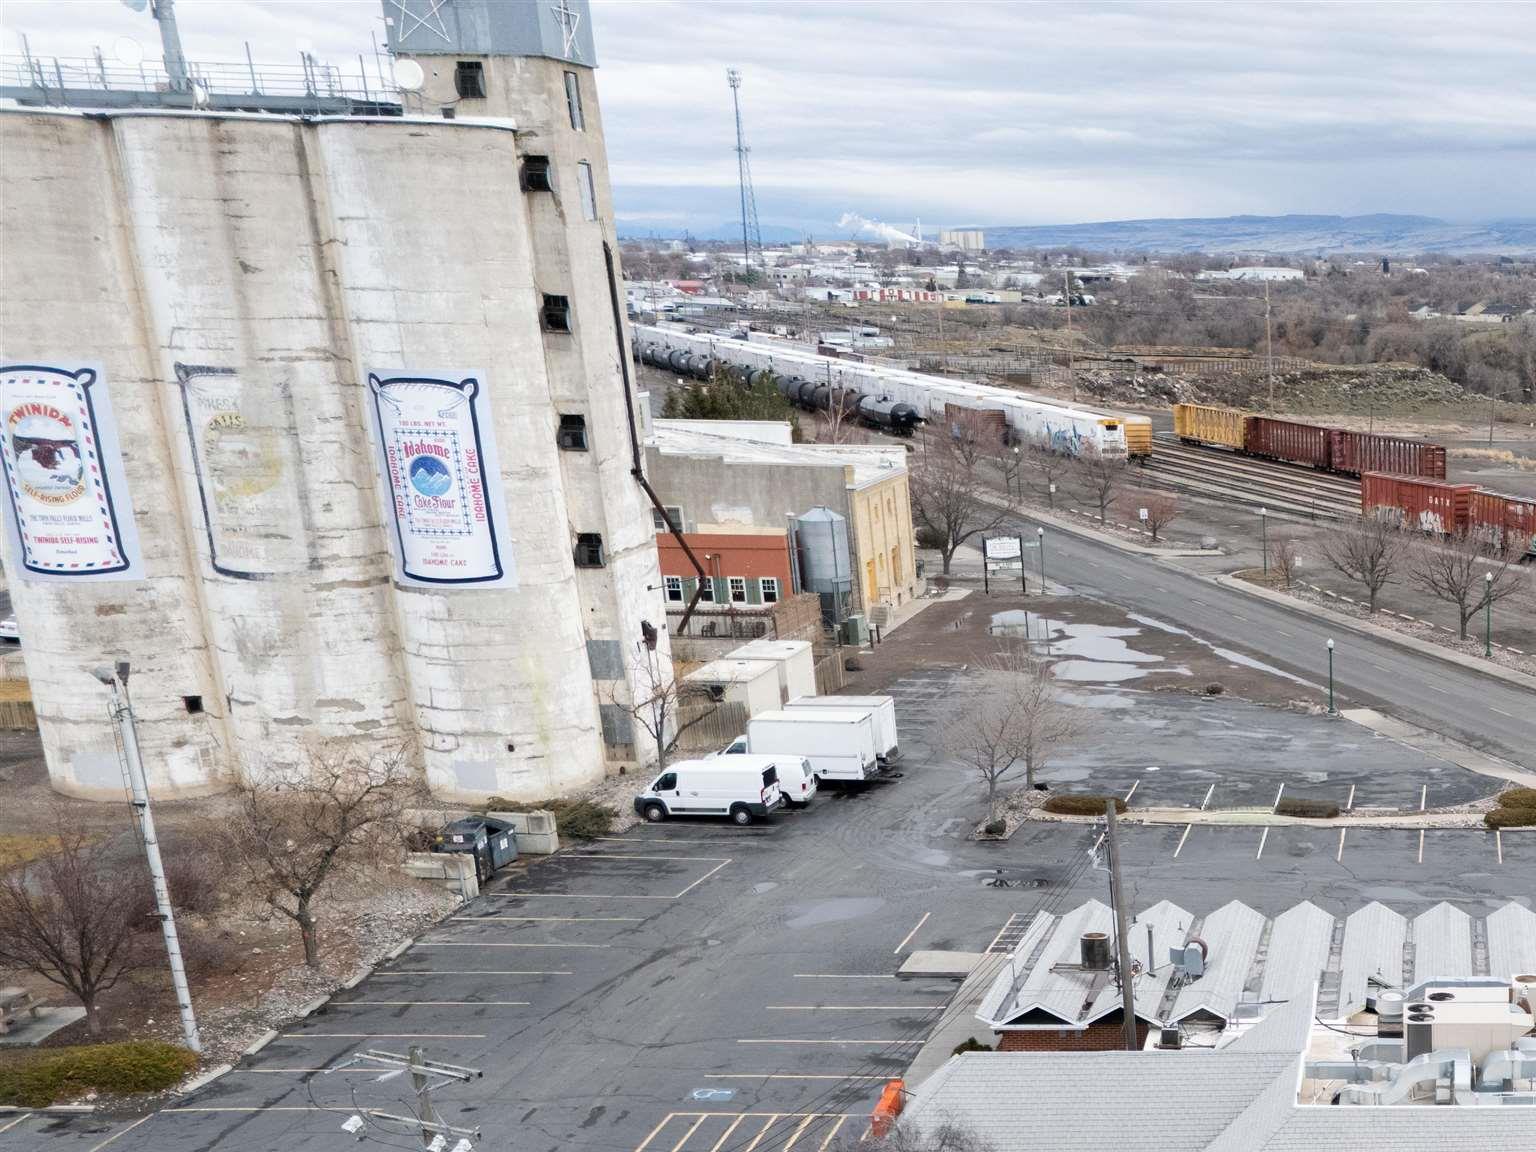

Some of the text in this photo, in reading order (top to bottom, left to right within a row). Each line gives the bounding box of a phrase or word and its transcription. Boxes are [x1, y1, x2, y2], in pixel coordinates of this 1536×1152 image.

[9, 403, 72, 428] TWINIDA
[403, 439, 450, 459] Idahome
[465, 448, 486, 522] IDAHOME CAKE
[414, 494, 456, 509] Cake Flour
